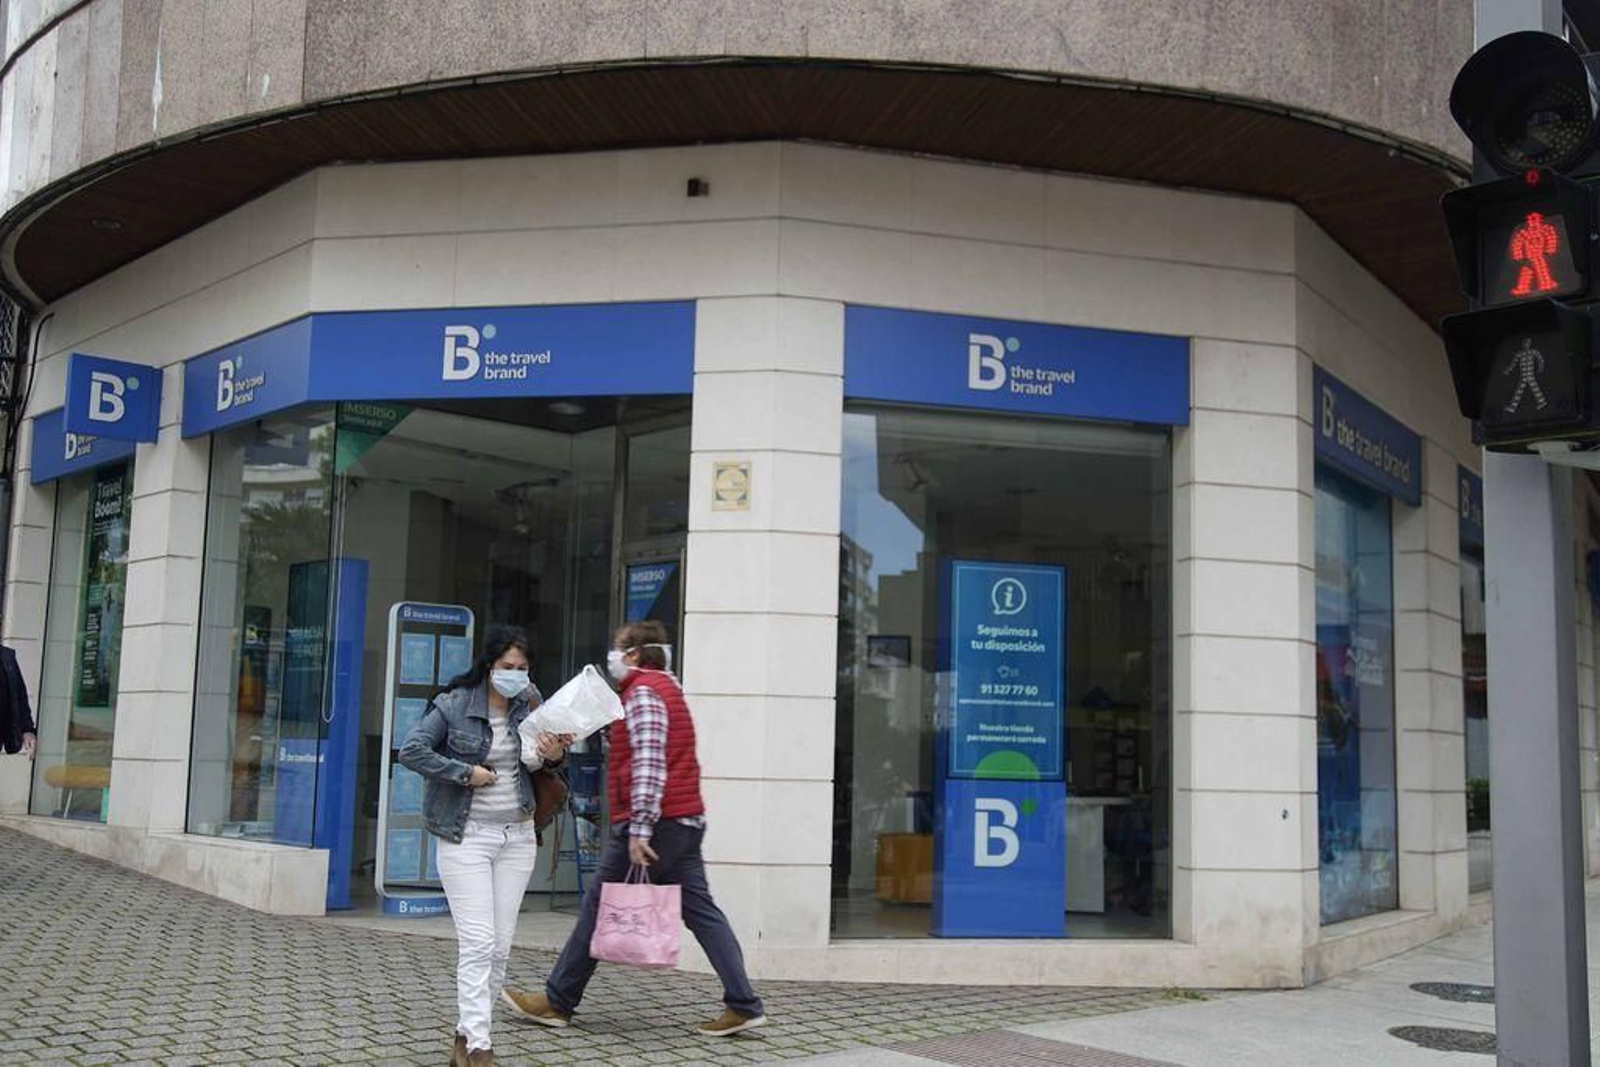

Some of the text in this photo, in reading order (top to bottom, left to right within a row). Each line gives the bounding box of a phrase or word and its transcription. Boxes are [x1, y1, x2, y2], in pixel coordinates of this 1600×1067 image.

[443, 325, 480, 380] B
[484, 350, 551, 365] the travel
[968, 333, 1006, 390] B
[484, 366, 527, 380] brand
[1010, 366, 1075, 384] the travel
[217, 360, 235, 412] B
[1010, 380, 1053, 396] brand
[88, 371, 126, 422] B
[1322, 384, 1336, 438] B
[1337, 418, 1355, 450] the
[977, 624, 1030, 638] Seguimos
[971, 639, 1045, 653] tu disposición
[981, 684, 992, 694] 91
[993, 684, 1011, 695] 327
[974, 798, 1020, 867] B
[399, 900, 408, 913] B
